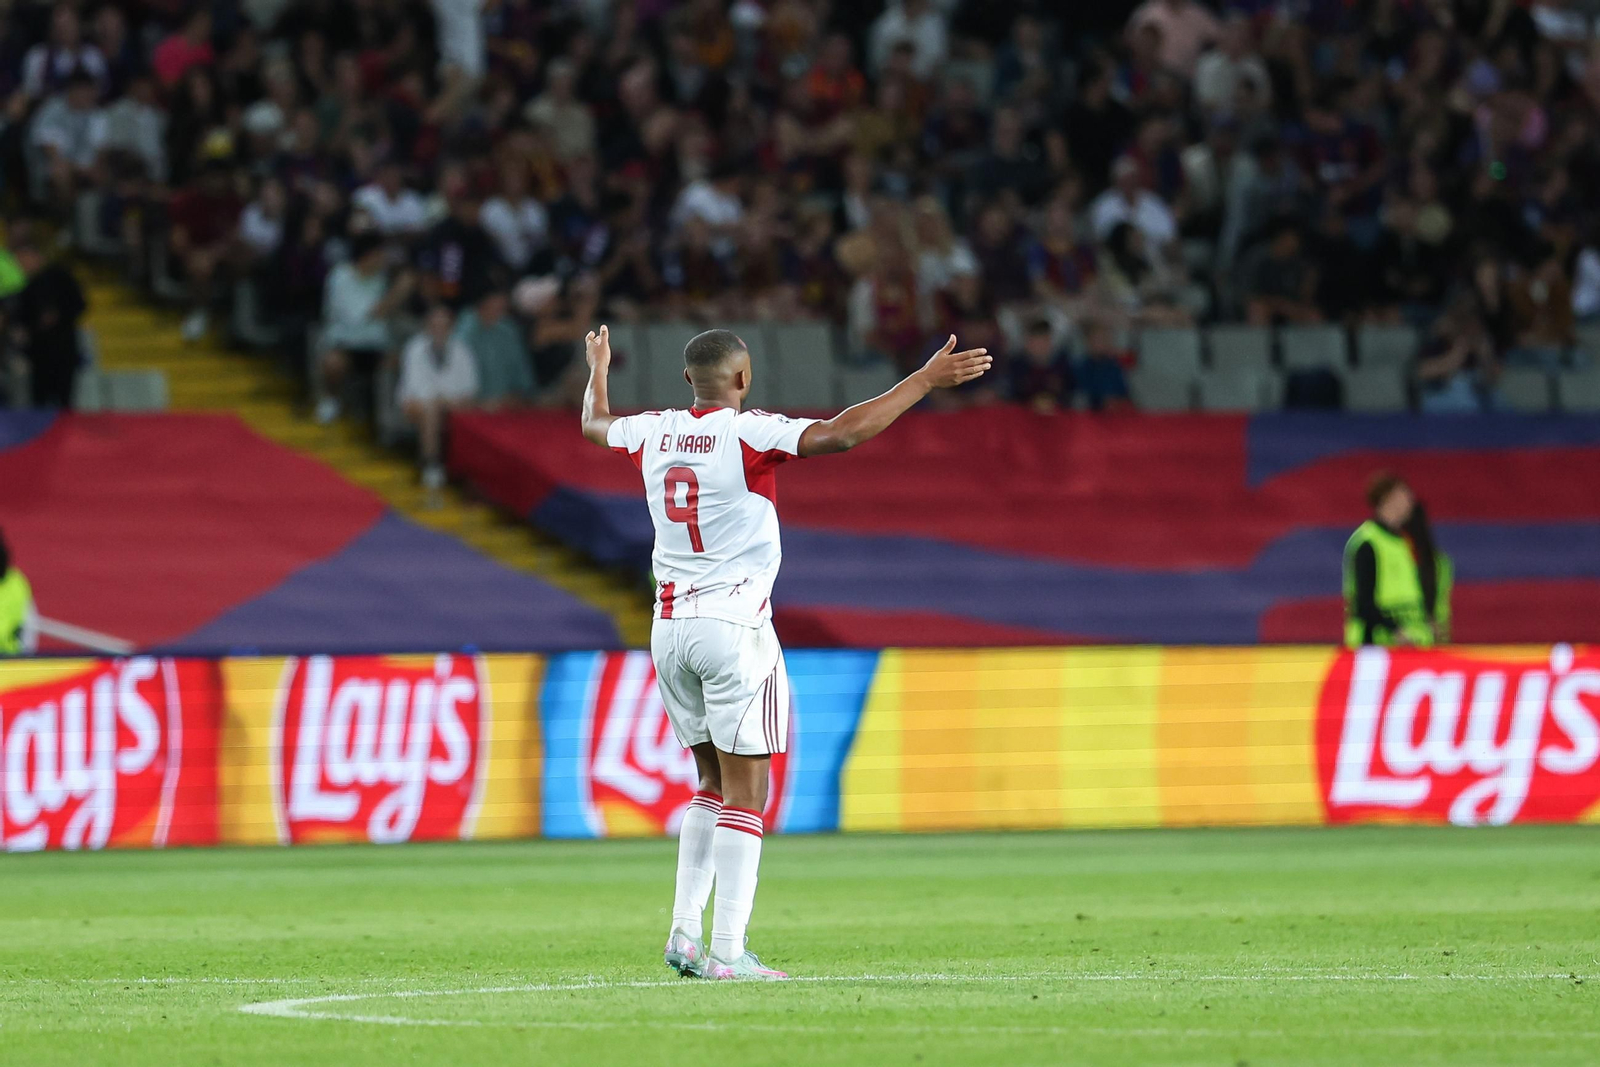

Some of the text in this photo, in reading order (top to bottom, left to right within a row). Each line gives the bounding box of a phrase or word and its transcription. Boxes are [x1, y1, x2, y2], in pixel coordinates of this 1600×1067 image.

[664, 466, 705, 552] 9
[675, 433, 716, 453] KAABI
[2, 656, 162, 852] ays
[288, 653, 476, 844] Lay's
[1329, 642, 1600, 827] Lay's
